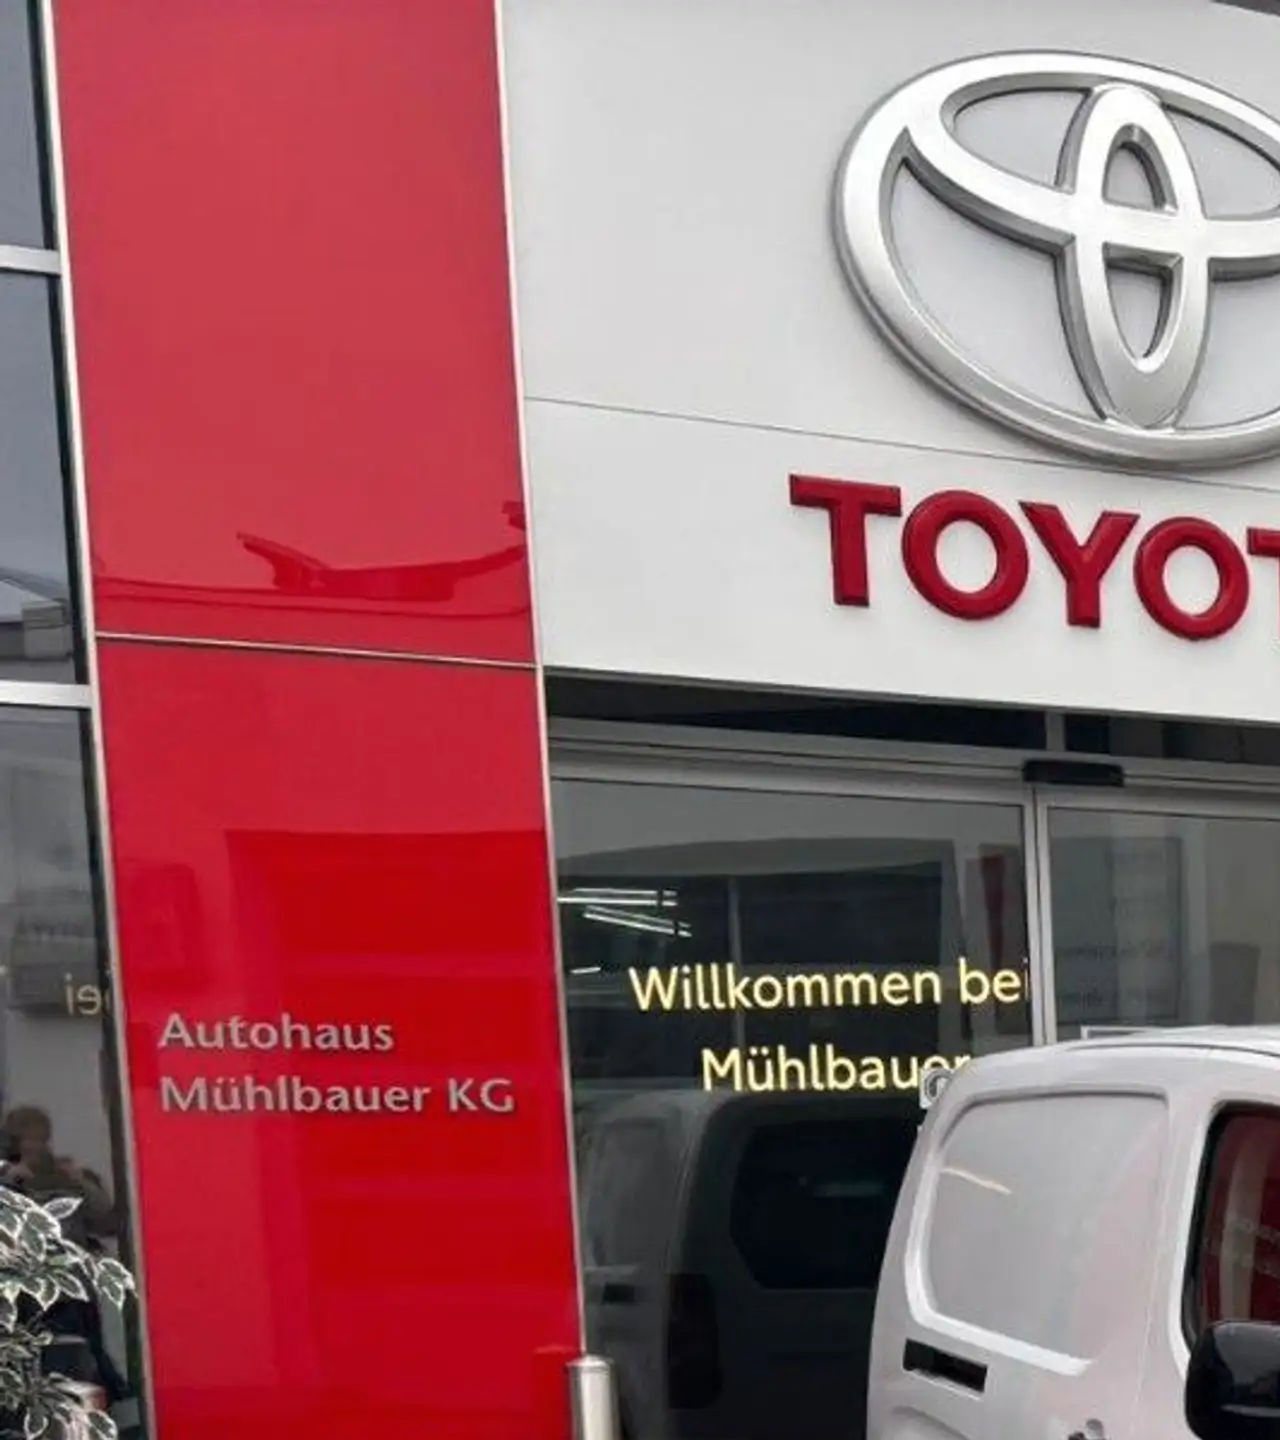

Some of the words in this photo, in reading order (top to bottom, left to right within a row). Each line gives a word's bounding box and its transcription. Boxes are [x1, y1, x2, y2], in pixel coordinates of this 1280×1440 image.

[628, 960, 942, 1011] Willkommen
[158, 1011, 395, 1051] Autohaus
[159, 1074, 432, 1114] Mühlbauer
[447, 1076, 515, 1113] KG
